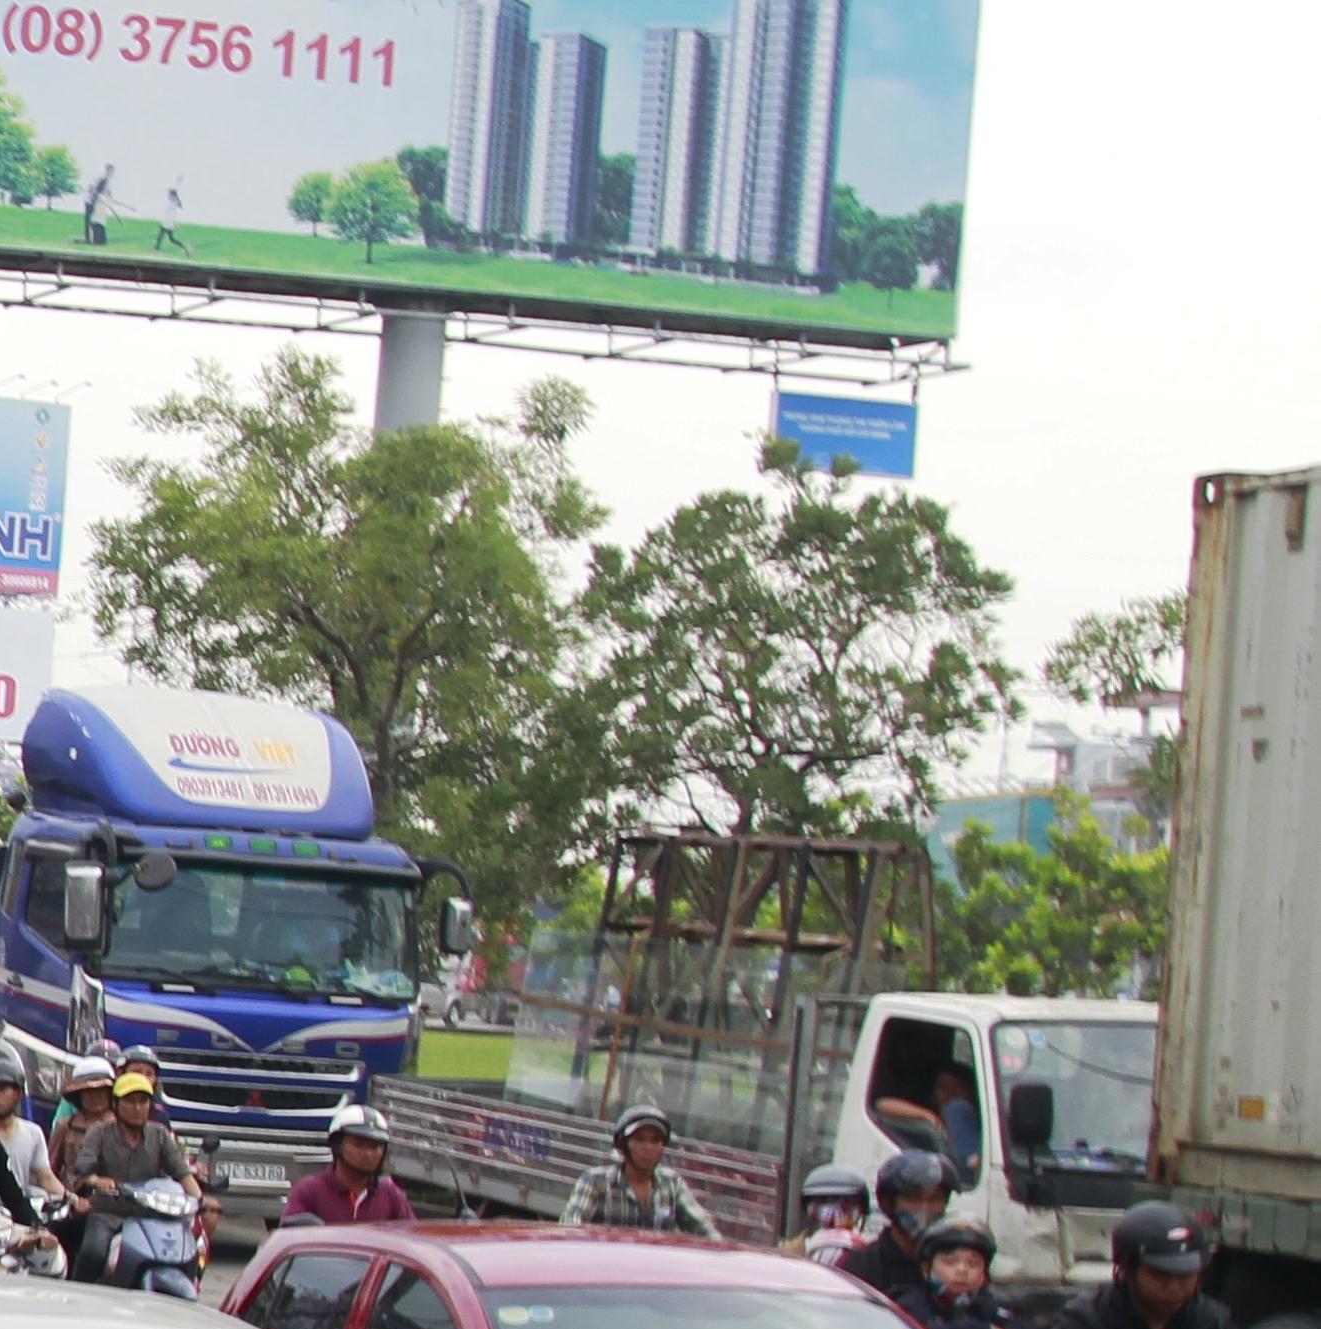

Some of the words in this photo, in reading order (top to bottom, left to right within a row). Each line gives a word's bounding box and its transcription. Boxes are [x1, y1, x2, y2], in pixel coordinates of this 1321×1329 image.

[2, 3, 103, 62] (08)
[119, 14, 253, 73] 3756
[272, 30, 396, 88] 1111
